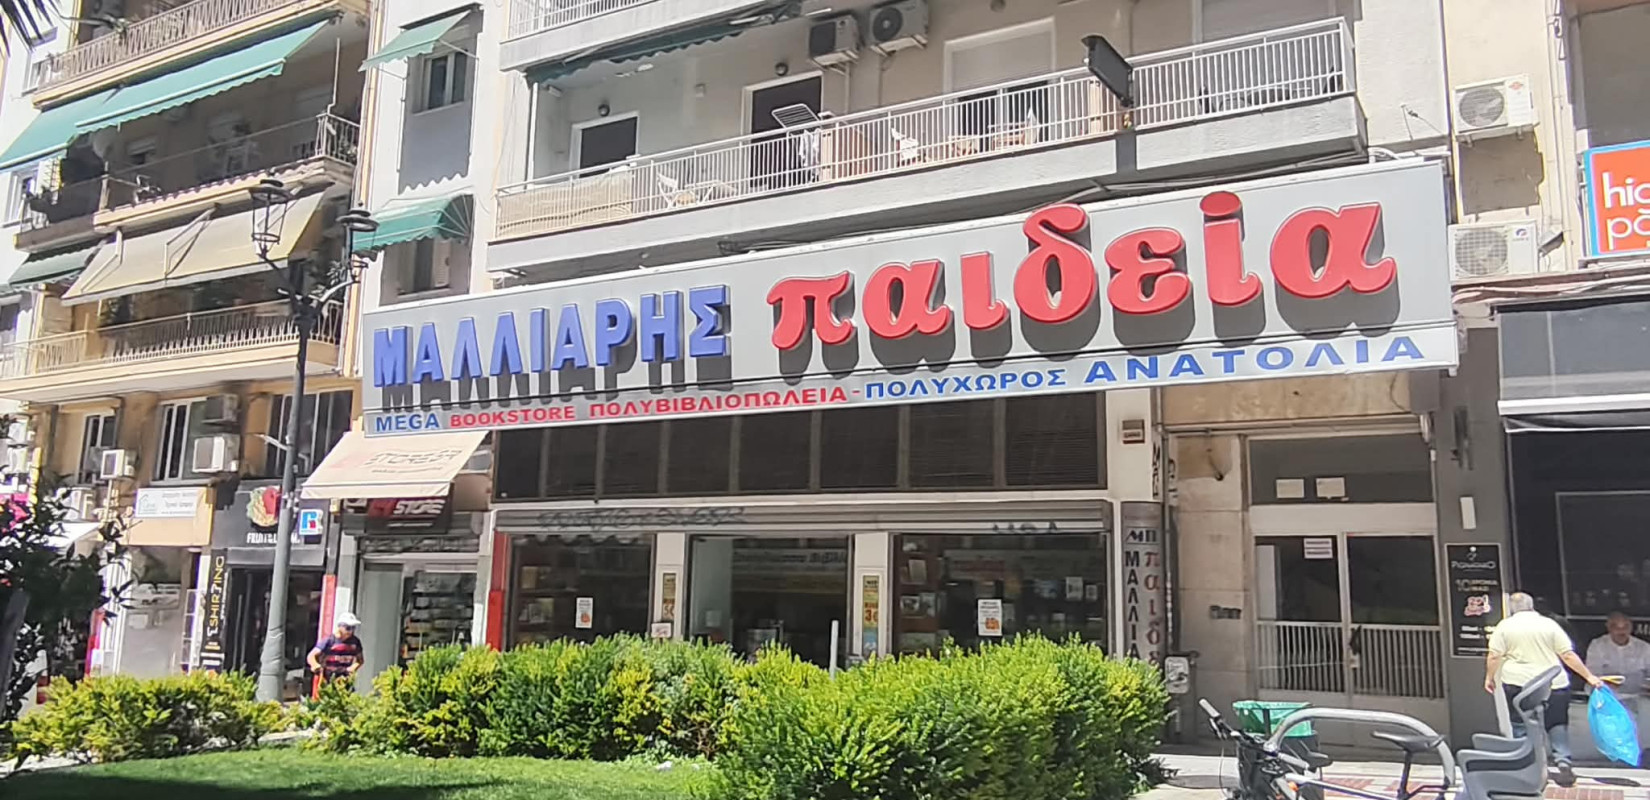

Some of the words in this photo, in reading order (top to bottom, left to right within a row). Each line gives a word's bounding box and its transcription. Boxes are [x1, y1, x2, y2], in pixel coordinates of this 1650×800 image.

[373, 284, 731, 387] ΜΑΛΛΙΑΡΗΣ
[767, 191, 1396, 349] παιδεία
[376, 413, 439, 432] MEGA
[450, 406, 576, 428] BOOKSTORE
[589, 387, 847, 418] ΠΟΛΥΒΙΒΛΙΟΠΩΛΕΙΑ
[865, 367, 1067, 399] ΠΟΛΥΧΩΡΟΣ
[1083, 336, 1426, 384] ΑΝΑΤΟΛΙΑ
